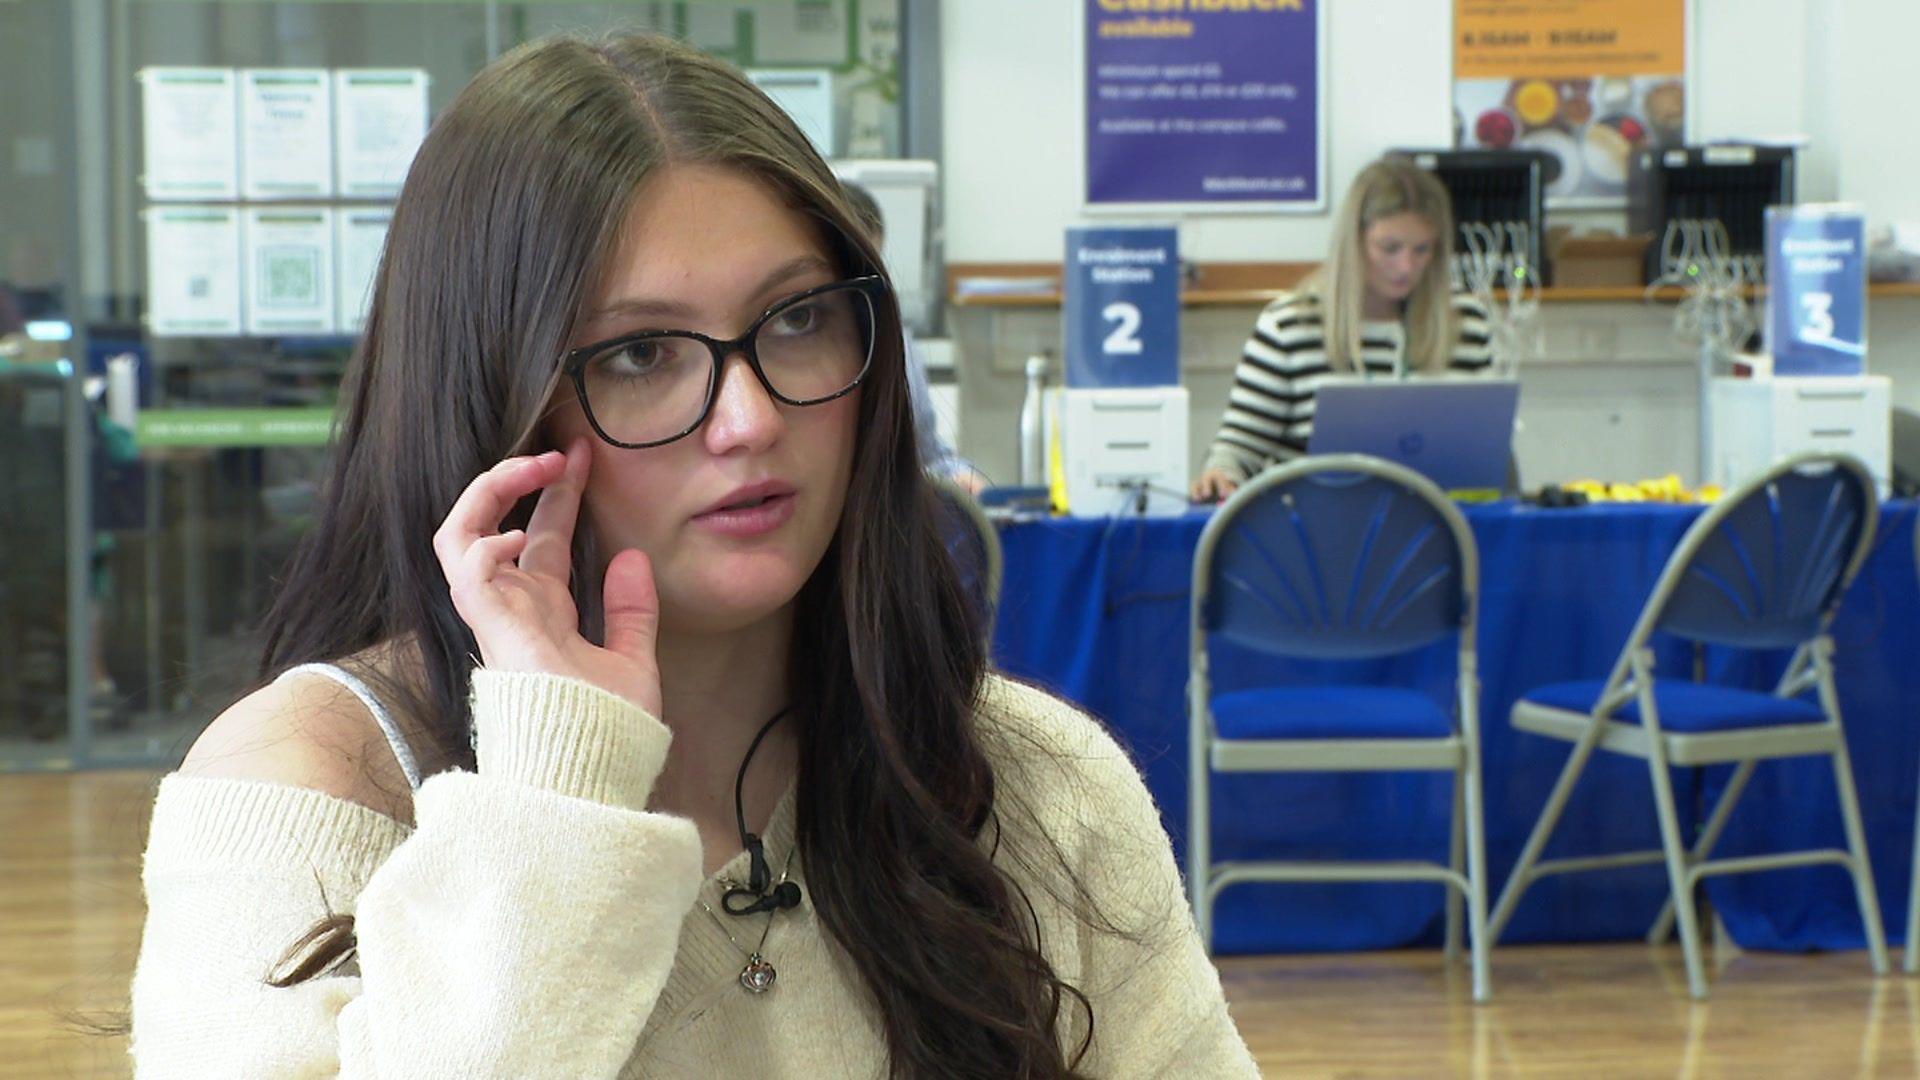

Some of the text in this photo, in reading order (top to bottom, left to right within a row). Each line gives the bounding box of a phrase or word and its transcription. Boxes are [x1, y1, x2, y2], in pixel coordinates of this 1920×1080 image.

[1099, 18, 1194, 36] available
[1099, 64, 1160, 76] Minimum
[1163, 64, 1202, 79] spend
[1124, 87, 1147, 97] can
[1149, 85, 1178, 97] offer
[1100, 118, 1156, 131] Available
[1078, 248, 1165, 262] Enrolment
[1092, 267, 1153, 281] Station
[1800, 292, 1834, 341] 3
[1102, 302, 1142, 354] 2
